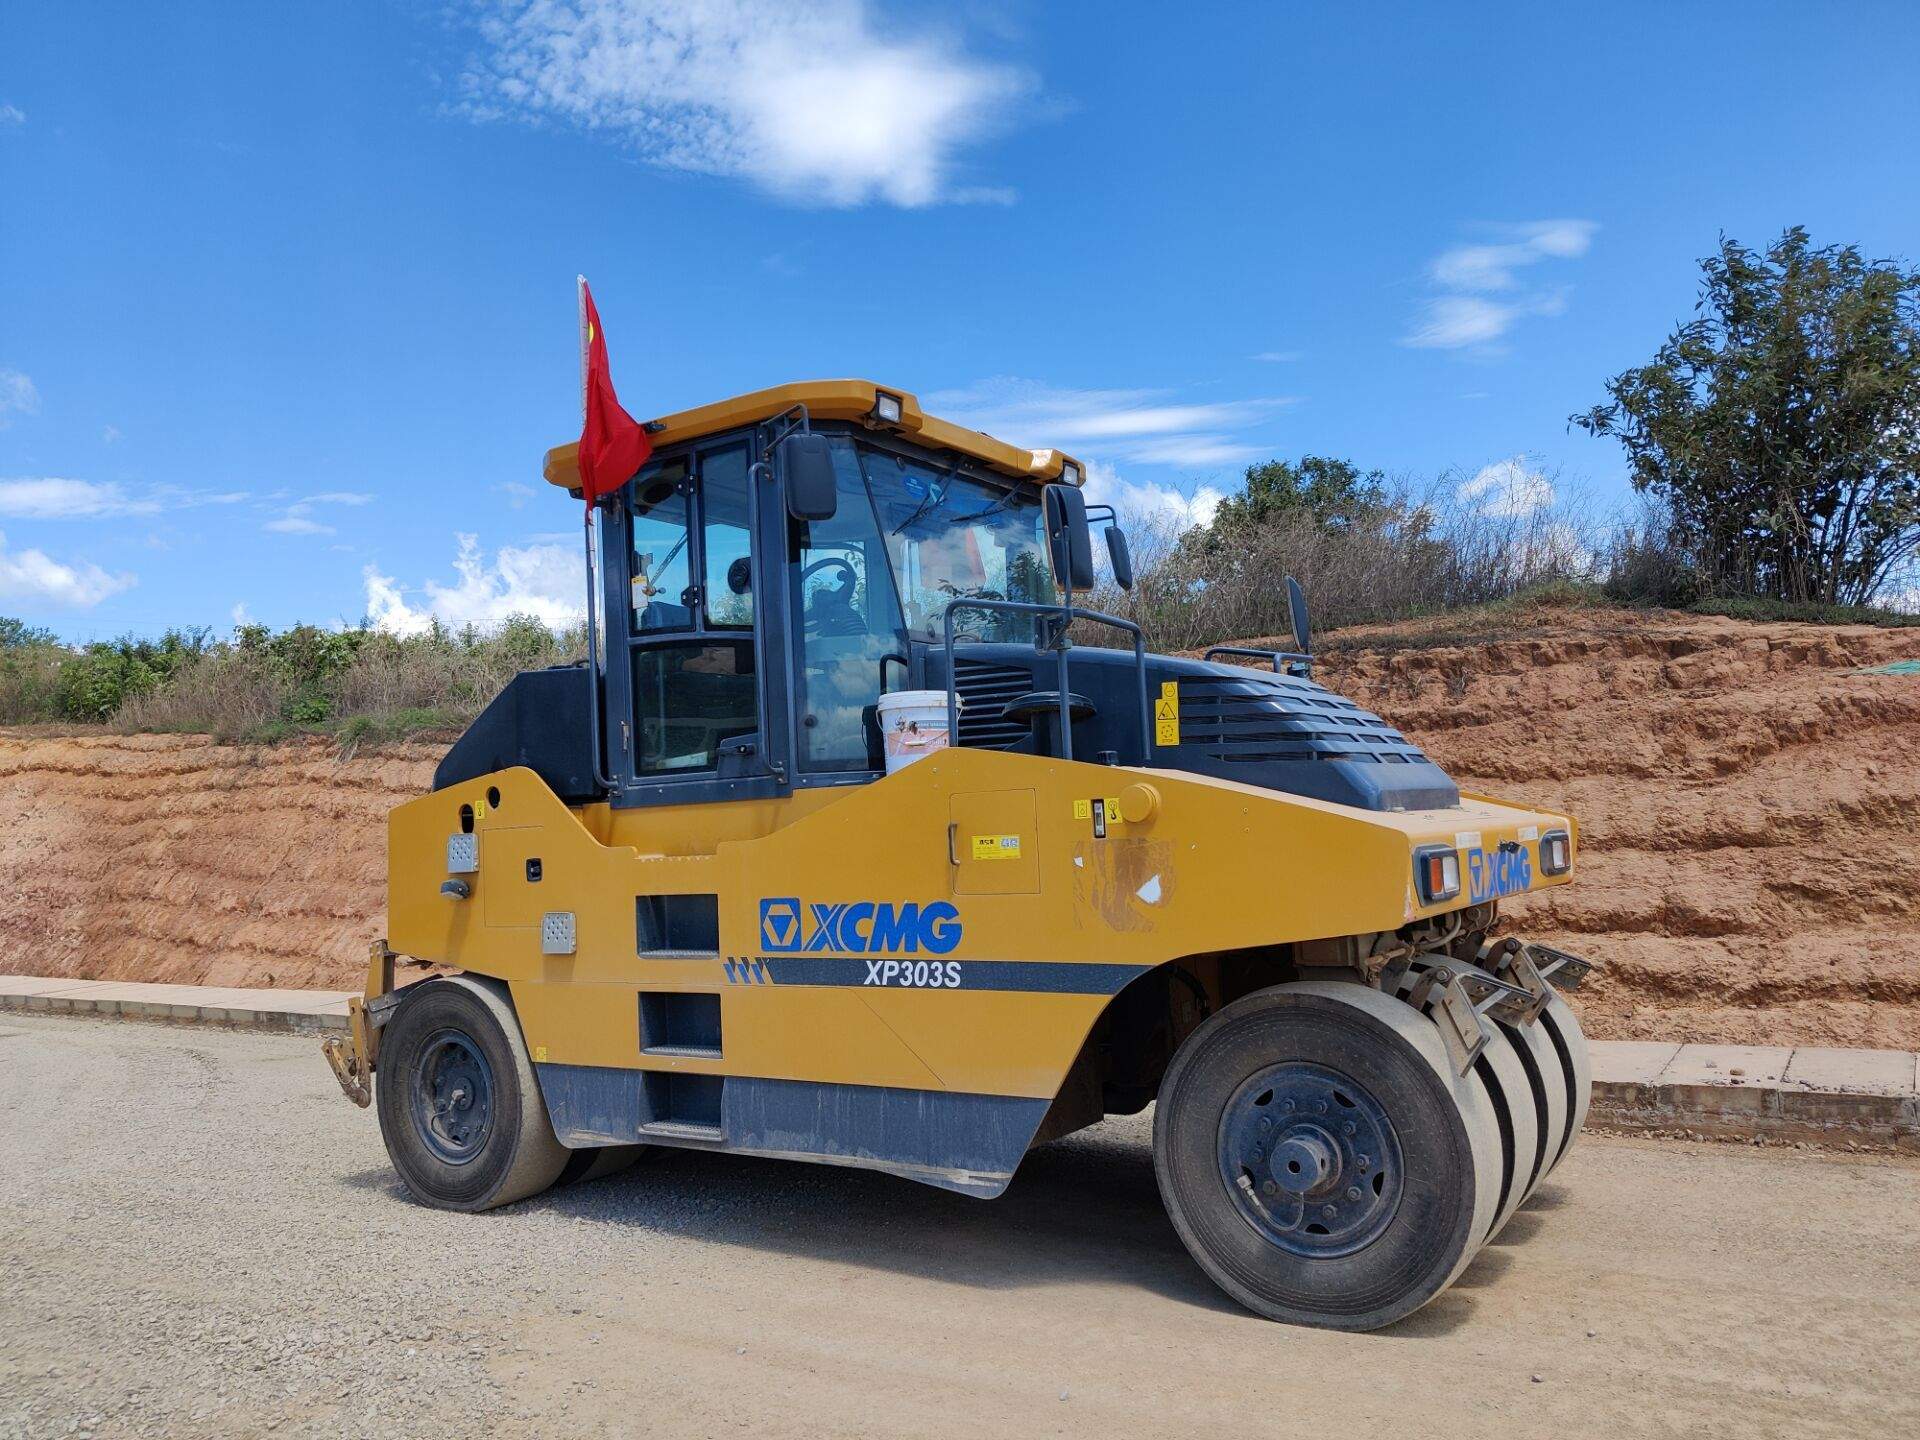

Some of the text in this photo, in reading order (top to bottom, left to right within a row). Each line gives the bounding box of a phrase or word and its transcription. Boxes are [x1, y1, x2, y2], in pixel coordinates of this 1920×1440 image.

[1487, 846, 1531, 898] XCMG
[802, 901, 963, 954] XCMG
[864, 960, 961, 988] XP303S
